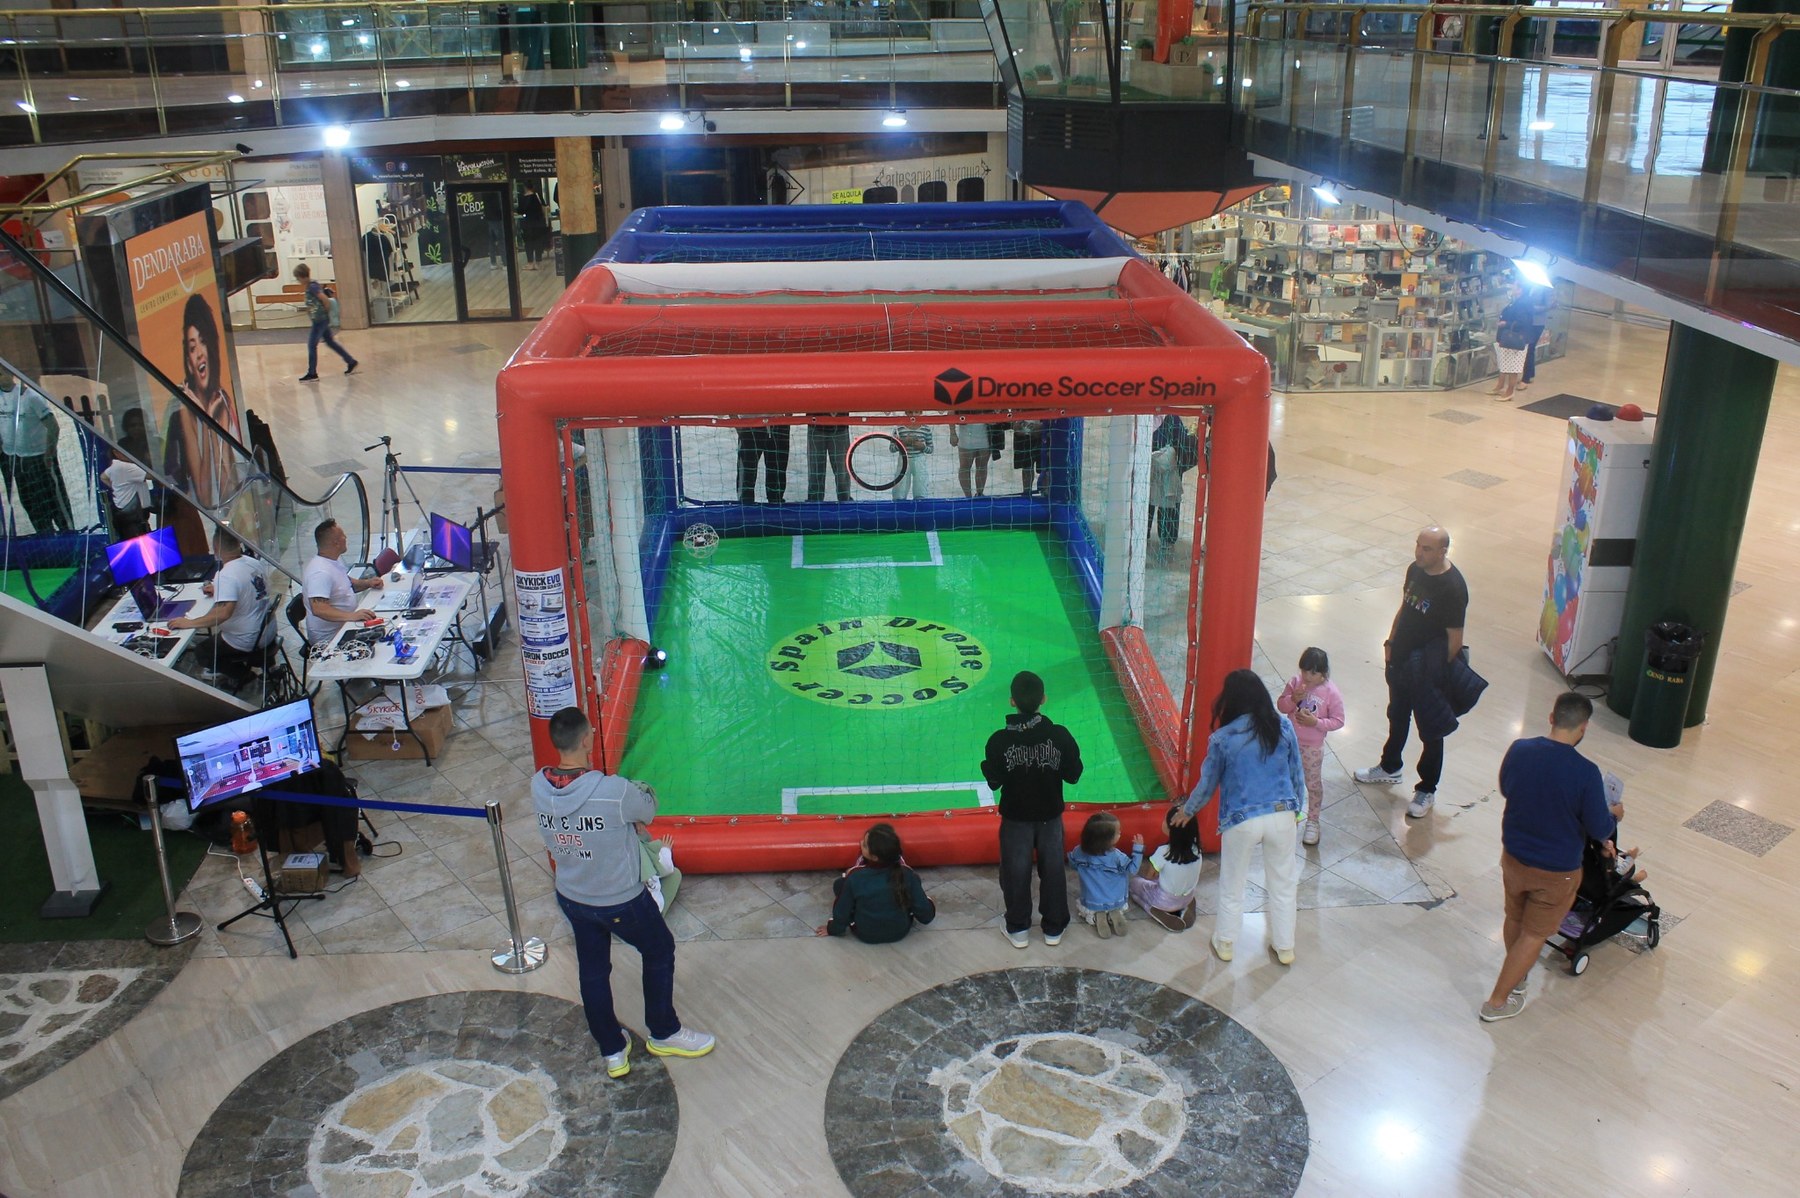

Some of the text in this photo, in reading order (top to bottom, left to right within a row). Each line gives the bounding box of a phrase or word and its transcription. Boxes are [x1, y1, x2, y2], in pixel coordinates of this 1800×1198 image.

[934, 167, 946, 182] de
[840, 190, 862, 198] ALQUILA
[463, 202, 481, 213] CBD
[132, 232, 206, 293] DENDARABA
[977, 375, 1217, 400] Drone Soccer Spain
[515, 573, 561, 586] SKYKICK EVO
[523, 651, 541, 661] DRON
[542, 648, 570, 660] SOCCER
[770, 616, 983, 705] Spain Drone Soccer
[575, 815, 605, 832] JNS
[554, 833, 584, 848] 1975
